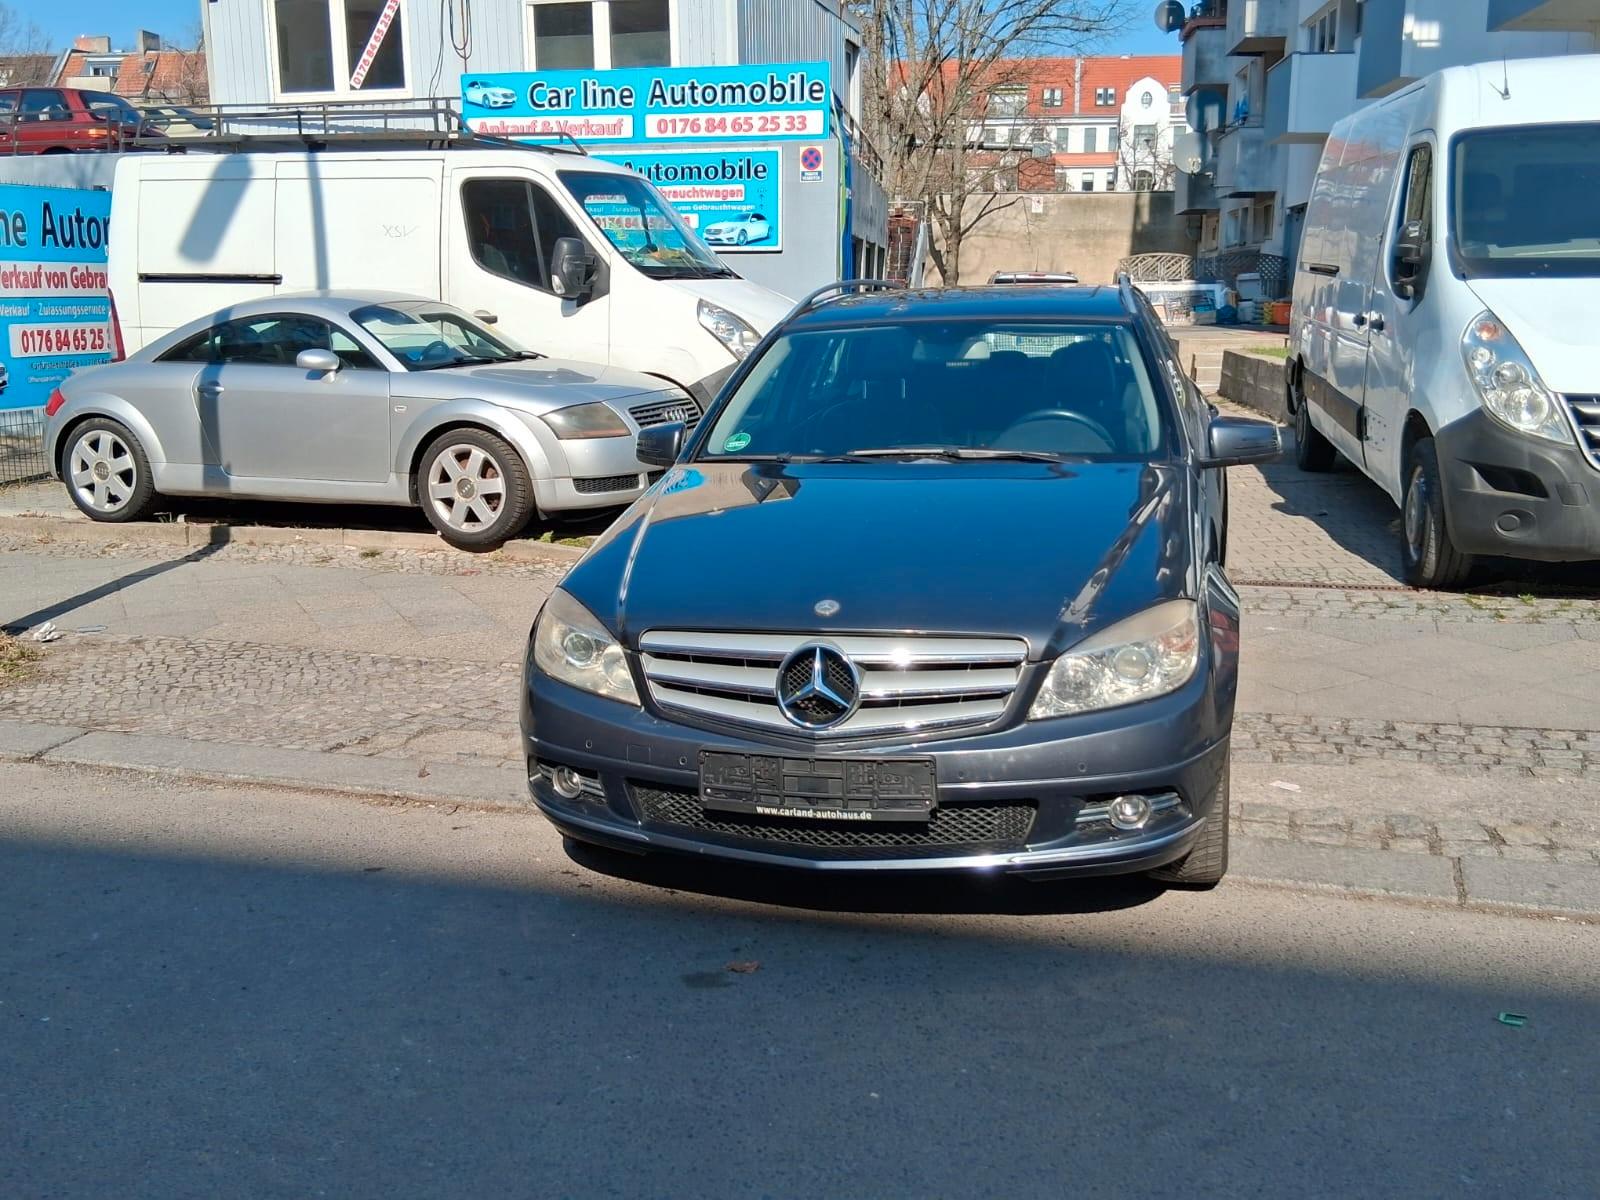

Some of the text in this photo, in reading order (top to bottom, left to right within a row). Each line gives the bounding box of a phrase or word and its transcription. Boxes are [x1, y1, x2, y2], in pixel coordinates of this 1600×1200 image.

[352, 59, 370, 86] 0176
[366, 43, 378, 59] 84
[373, 28, 385, 43] 65
[380, 13, 392, 28] 25
[528, 73, 825, 109] Car line Automobile
[478, 118, 624, 136] Ankauf & Verkauf
[656, 114, 808, 134] 0176 84 65 25 33
[0, 264, 42, 289] erkauf
[45, 271, 68, 289] von
[38, 302, 106, 319] Zulassungsservice
[21, 329, 53, 353] 0176
[55, 329, 71, 352] 84
[72, 328, 88, 351] 65
[89, 328, 105, 350] 25
